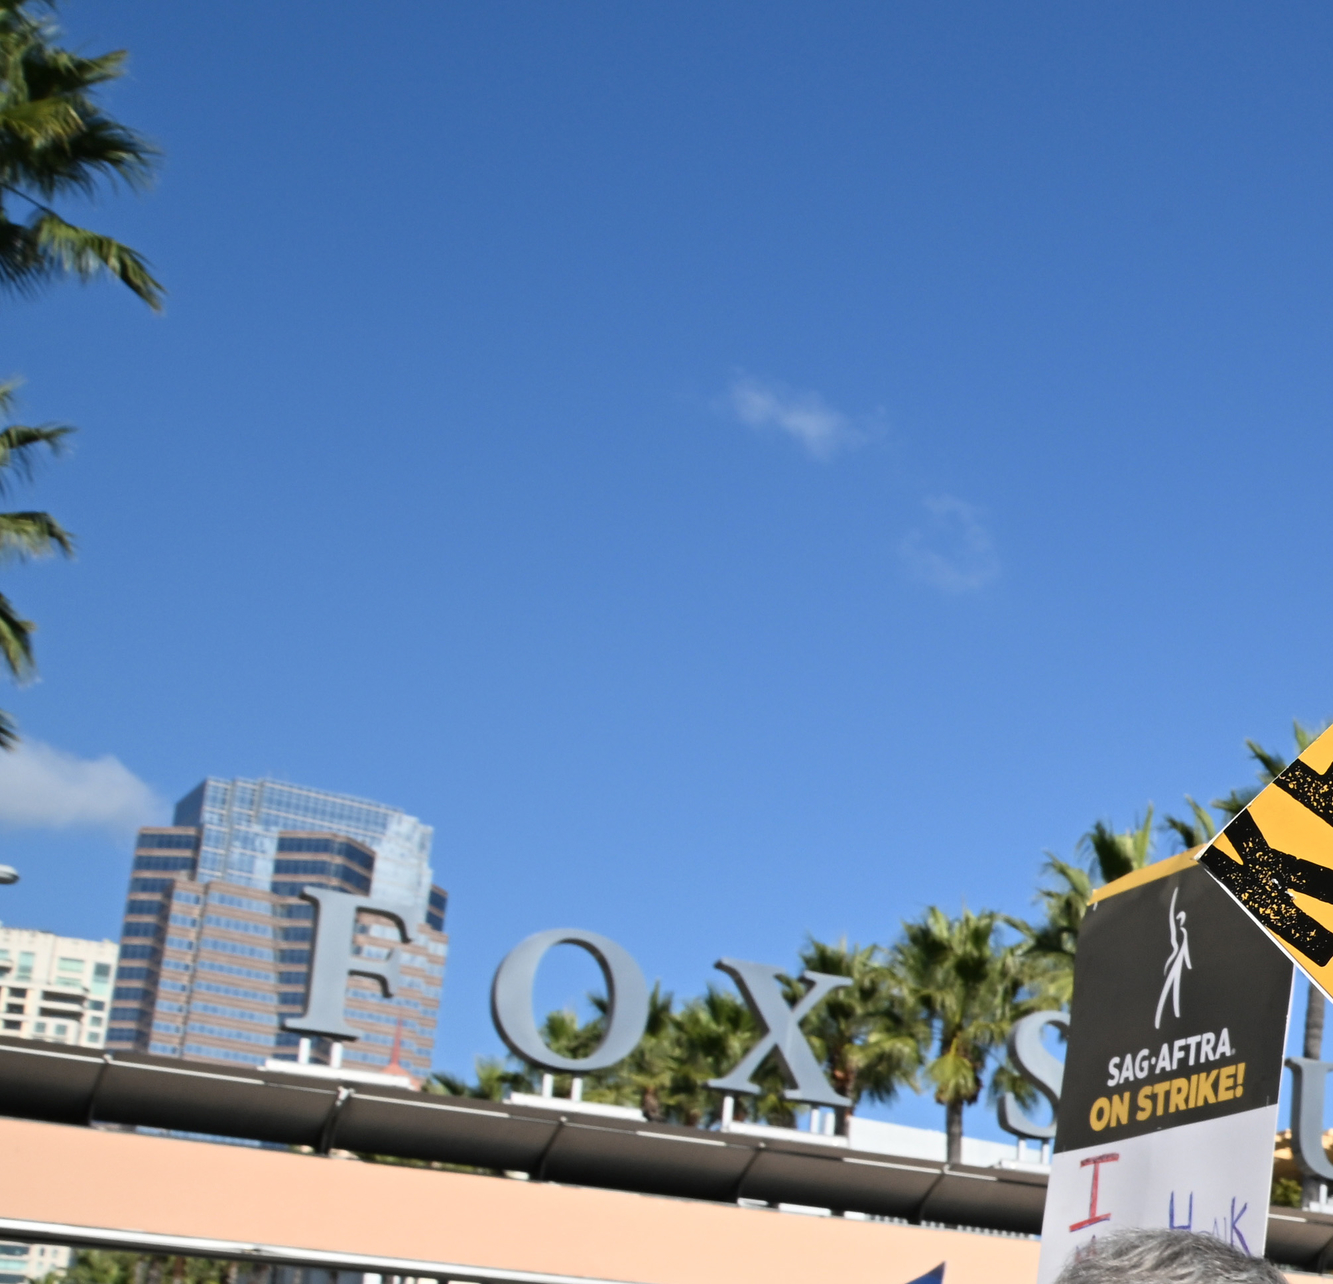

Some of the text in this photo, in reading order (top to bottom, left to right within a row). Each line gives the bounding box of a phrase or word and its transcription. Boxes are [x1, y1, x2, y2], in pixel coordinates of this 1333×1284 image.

[284, 885, 855, 1109] FOX
[1089, 1062, 1246, 1131] ON STRIKE!
[1069, 1152, 1120, 1232] I
